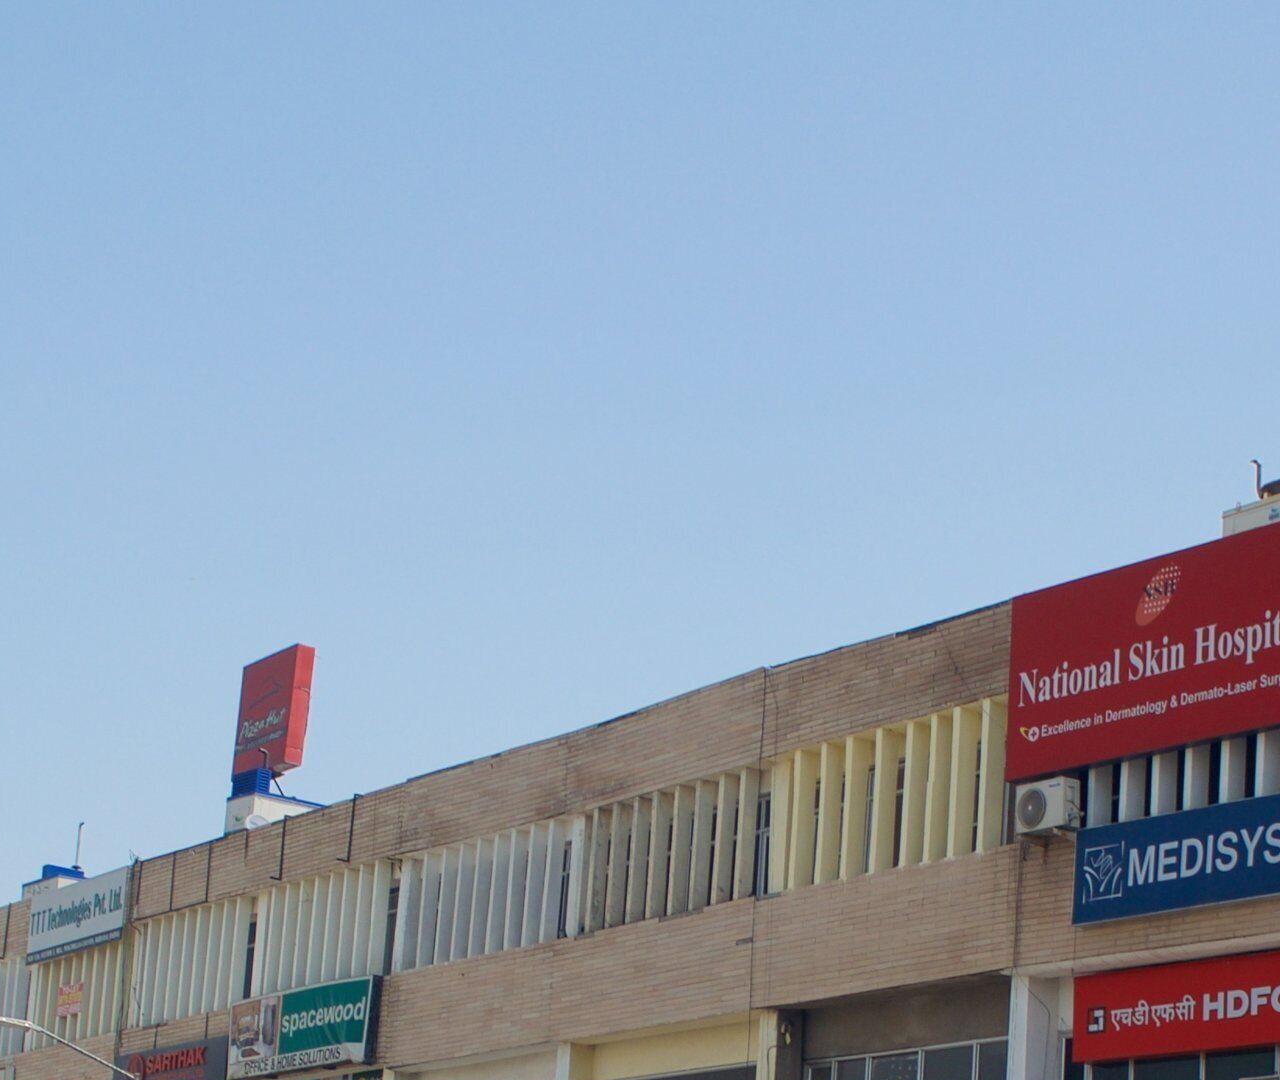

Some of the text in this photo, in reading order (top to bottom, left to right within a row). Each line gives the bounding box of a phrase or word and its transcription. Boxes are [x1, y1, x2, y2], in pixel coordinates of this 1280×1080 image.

[1018, 648, 1120, 707] National
[1128, 635, 1185, 682] Skin
[1041, 715, 1091, 738] Excellence
[1094, 713, 1103, 725] in
[1105, 696, 1167, 724] Dermatology
[1170, 695, 1178, 707] &
[1180, 678, 1257, 706] Dermato-Laser
[48, 896, 92, 931] Technologies
[281, 996, 366, 1037] spacewood
[146, 1045, 207, 1074] SARTHAK
[244, 1046, 341, 1074] OFFICE HOME SOLUTIONS
